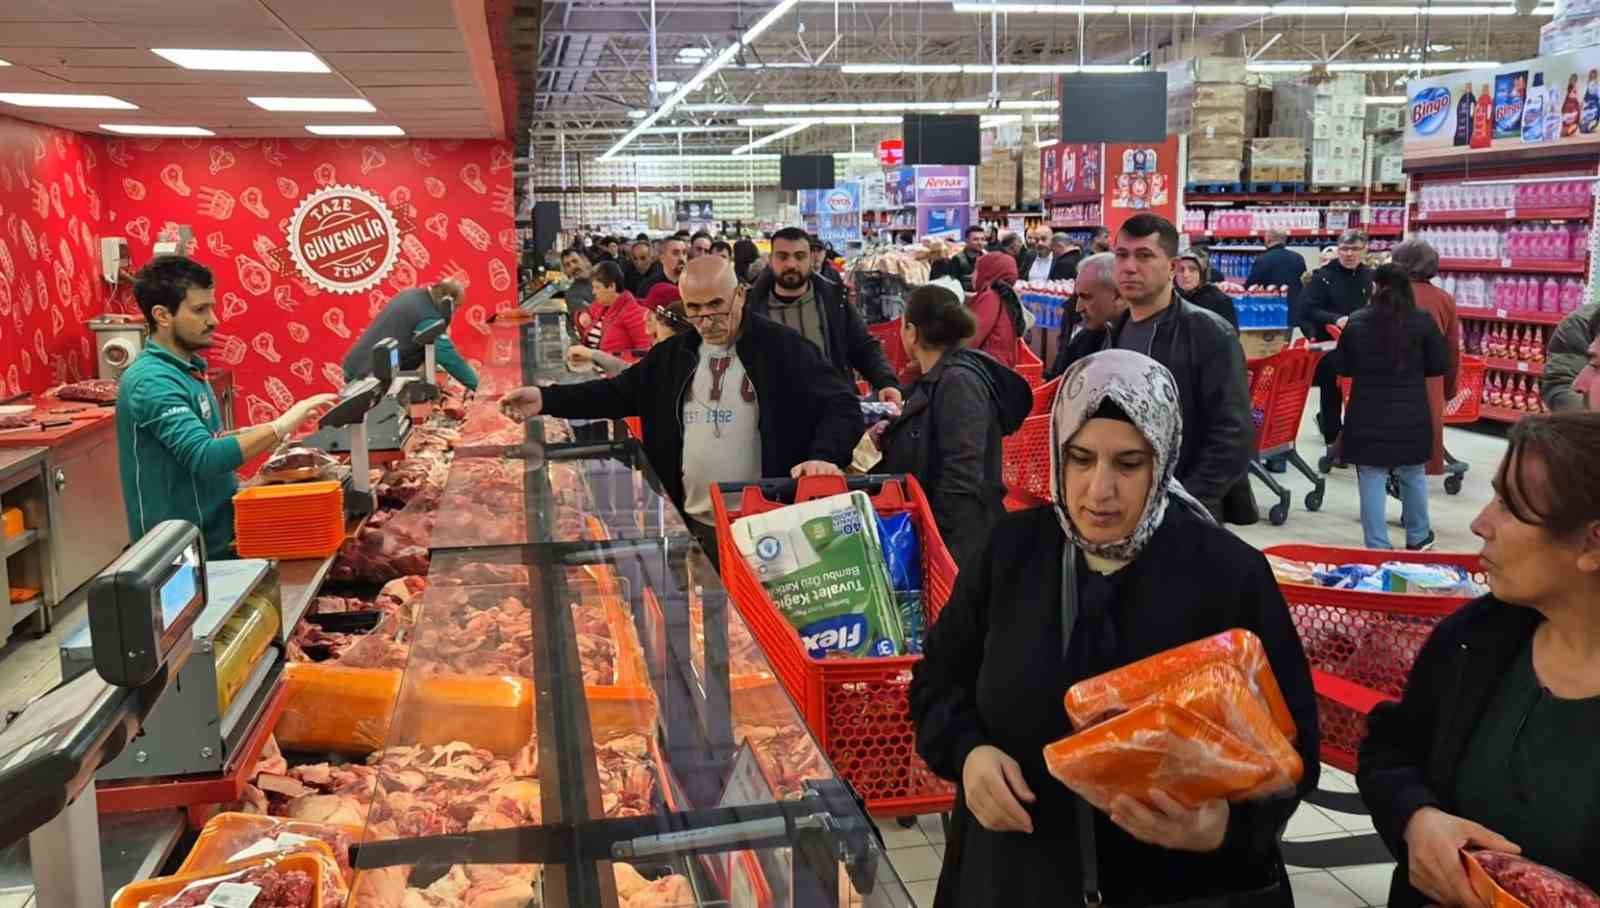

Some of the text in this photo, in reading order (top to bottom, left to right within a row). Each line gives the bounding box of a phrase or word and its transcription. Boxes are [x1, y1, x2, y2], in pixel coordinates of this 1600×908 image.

[1412, 95, 1450, 125] Bingo
[311, 199, 352, 221] TAZE
[303, 217, 385, 261] GÜVENİLİR
[822, 565, 861, 583] Bambu
[811, 579, 865, 601] Tuvalet
[880, 640, 892, 654] 3
